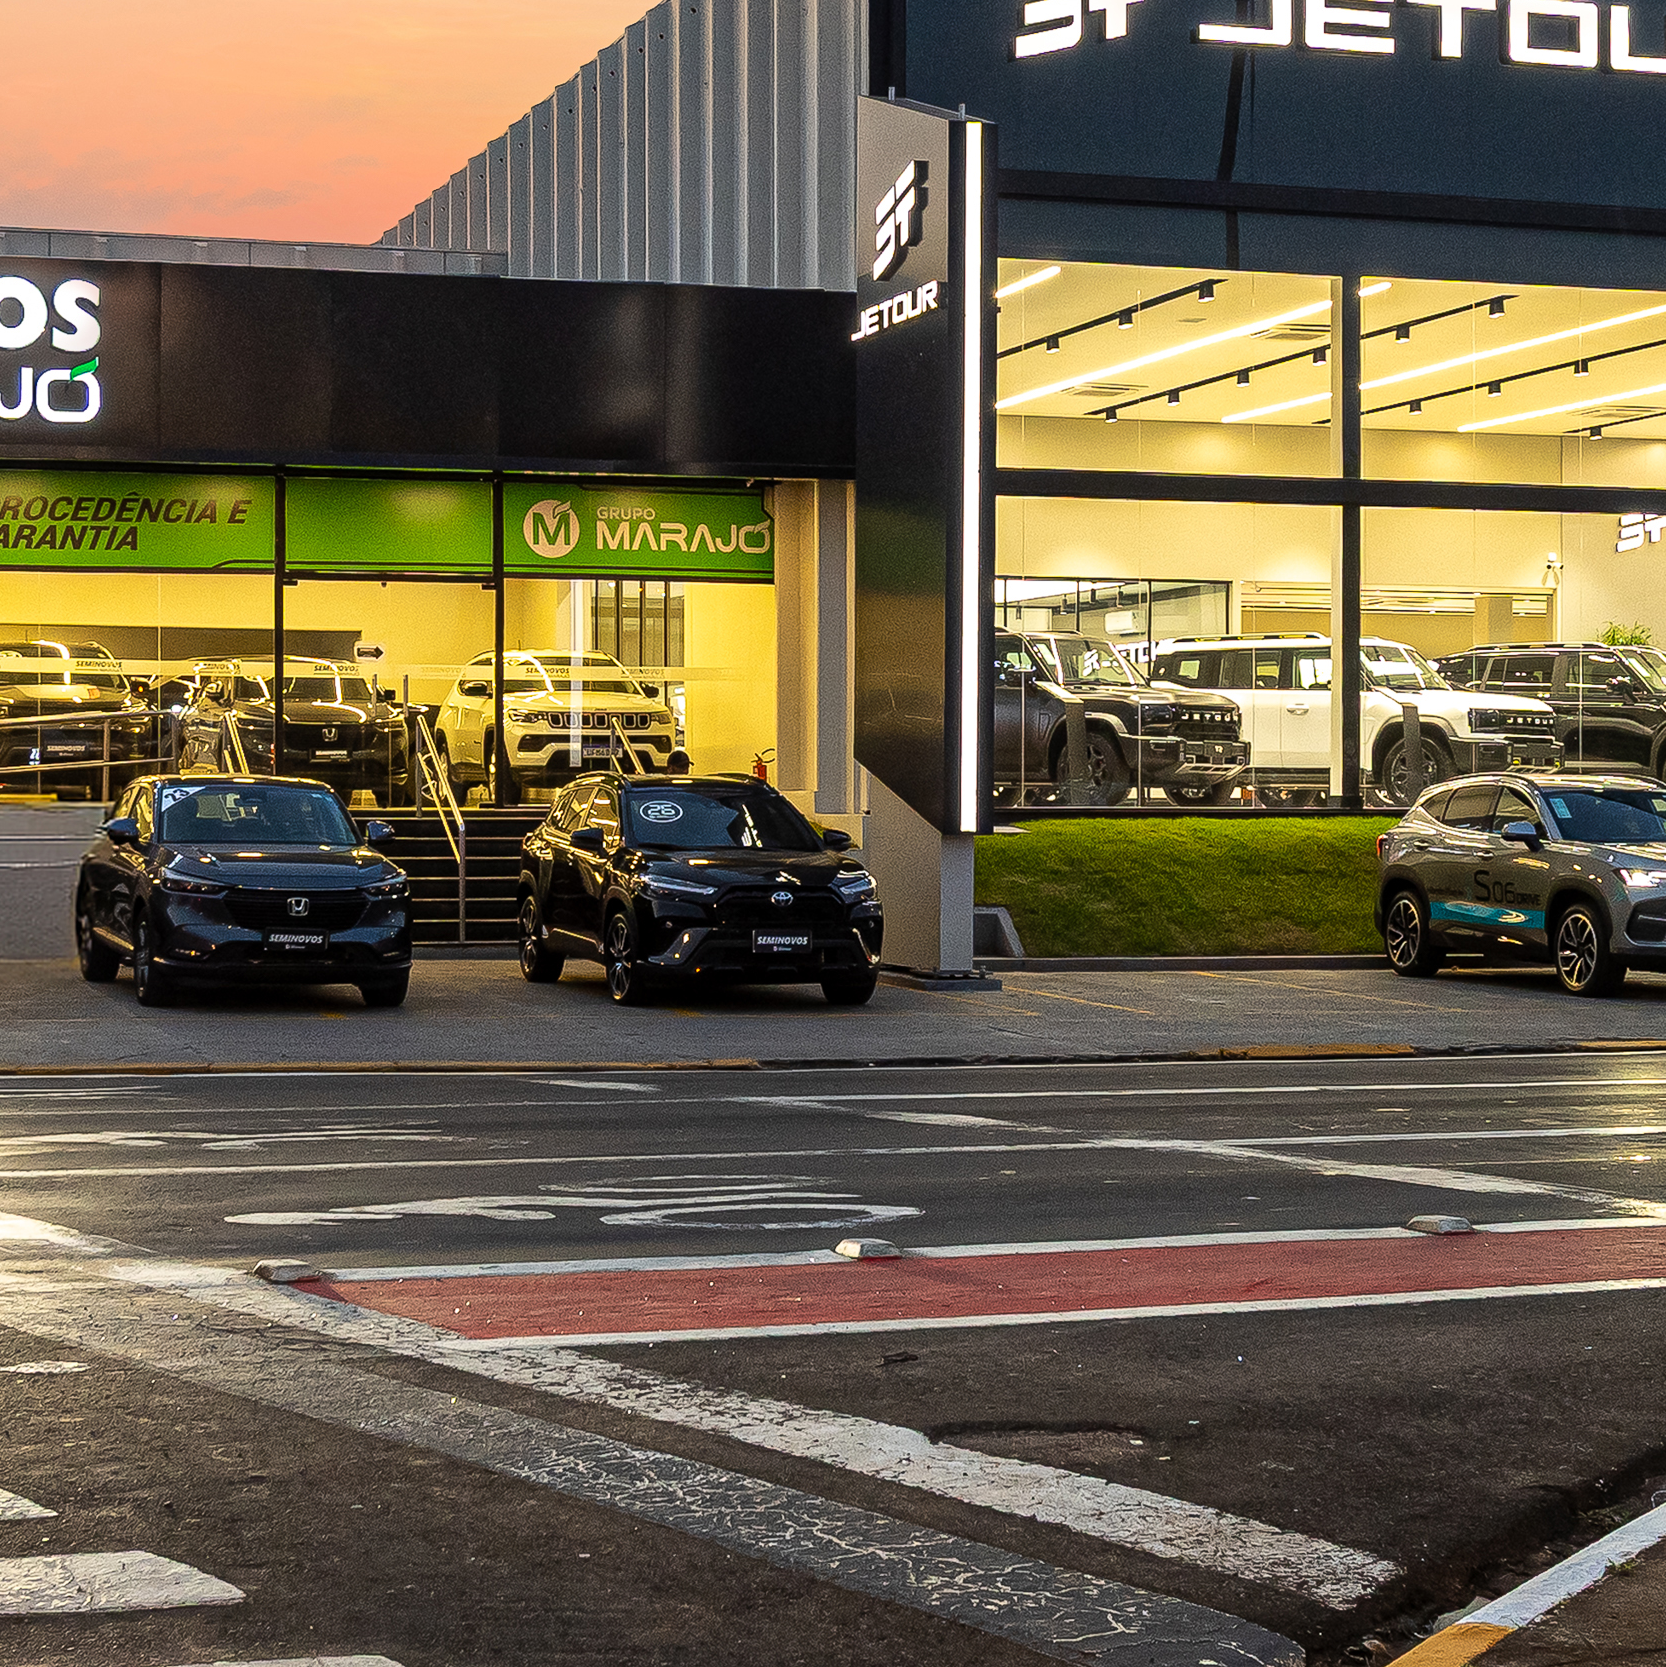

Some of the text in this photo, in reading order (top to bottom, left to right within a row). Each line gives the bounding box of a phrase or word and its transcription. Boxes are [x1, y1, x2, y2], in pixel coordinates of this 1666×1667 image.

[850, 279, 938, 342] JETOUR
[227, 498, 253, 525] E
[596, 506, 656, 521] GRUPO
[596, 519, 771, 554] MARAJÓ
[268, 934, 324, 944] SEMINOVOS
[757, 935, 809, 945] SEMINOVOS
